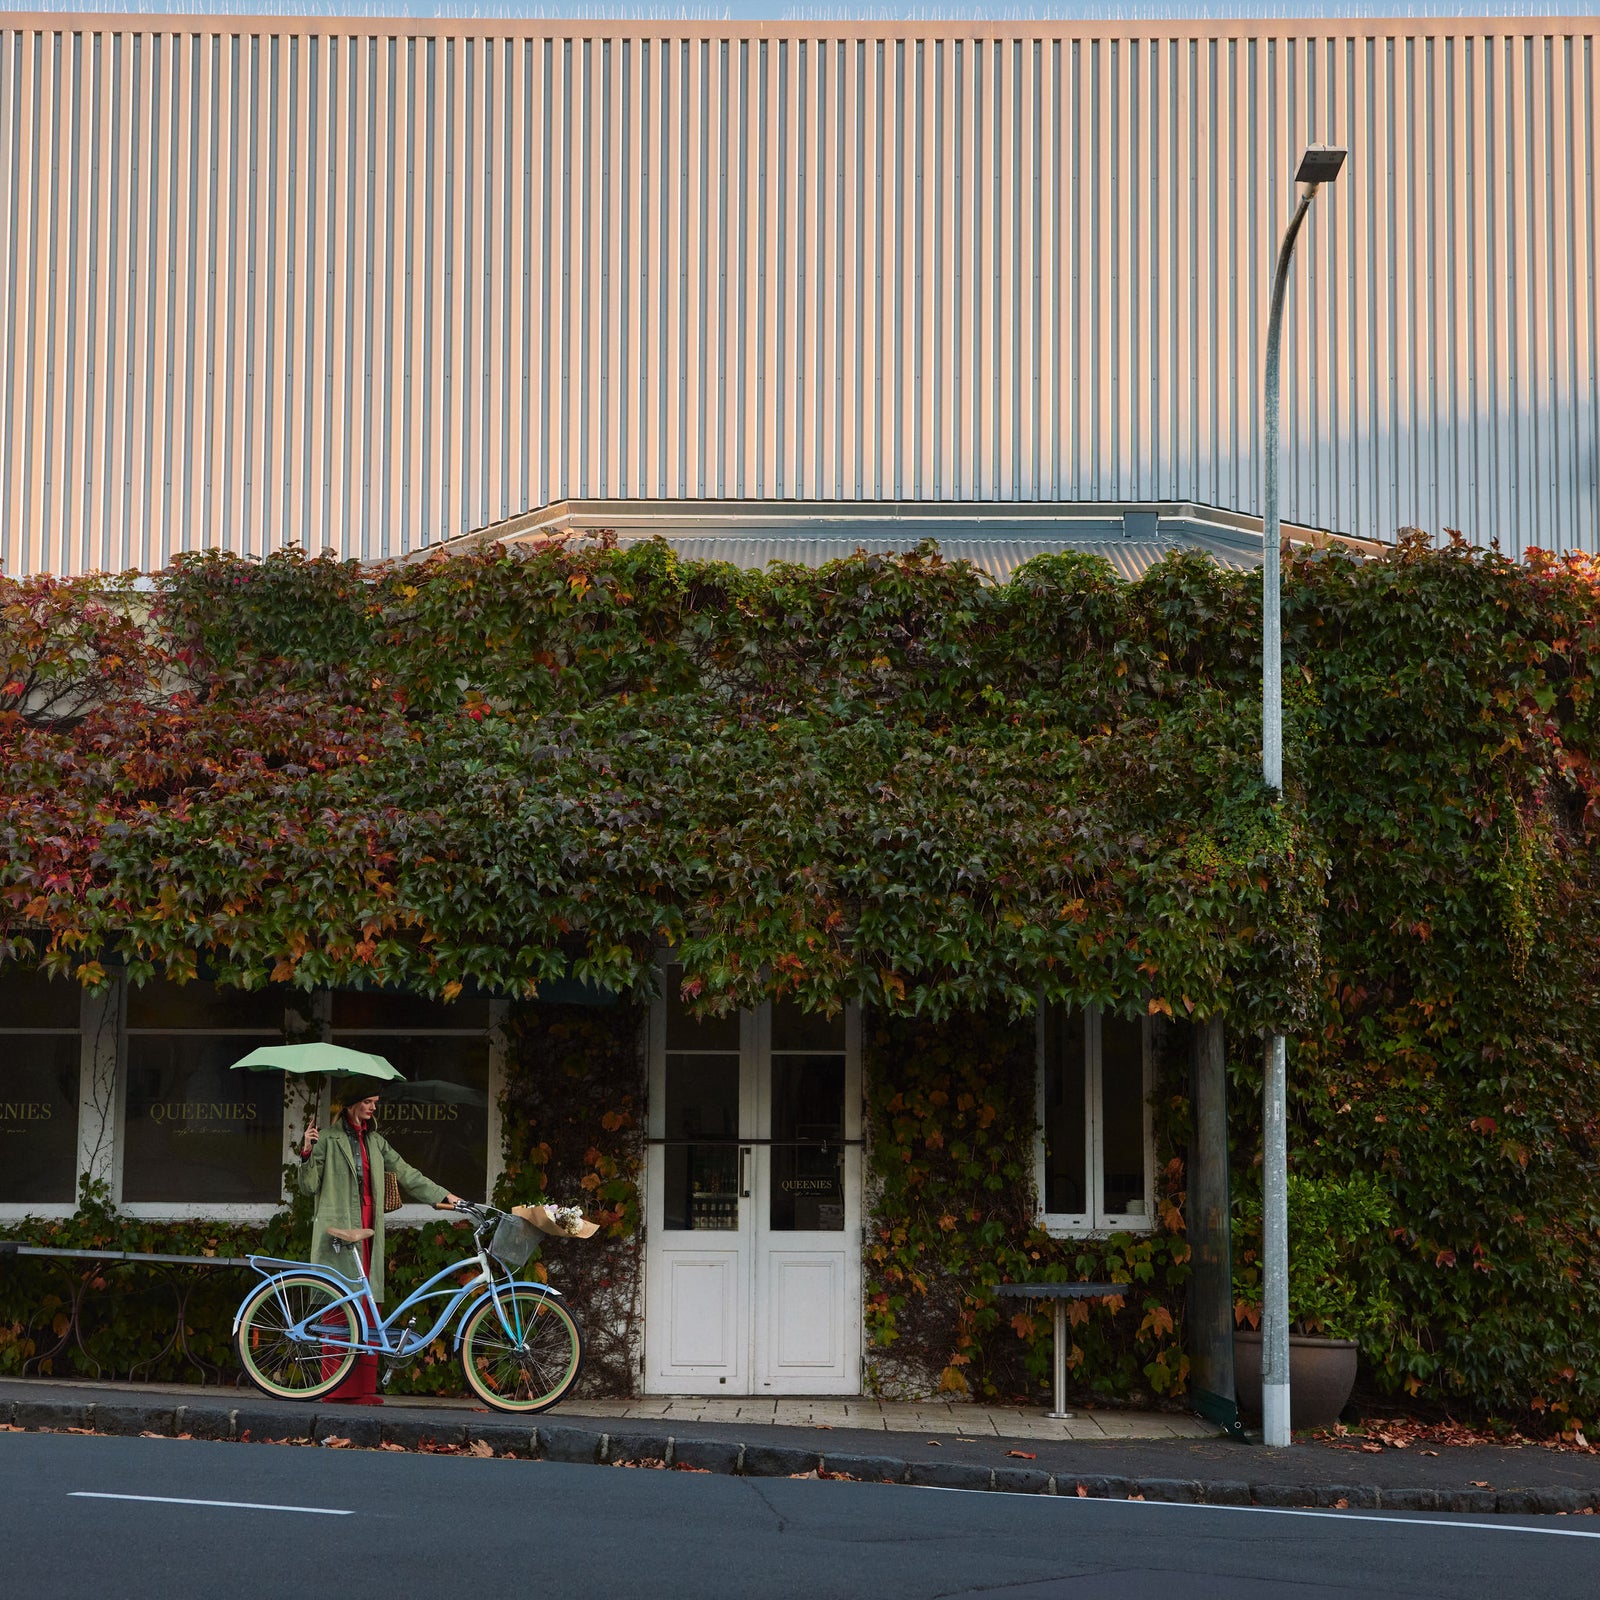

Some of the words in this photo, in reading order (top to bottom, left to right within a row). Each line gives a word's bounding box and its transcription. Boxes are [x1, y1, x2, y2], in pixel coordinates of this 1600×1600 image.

[0, 1103, 52, 1120] NIES
[149, 1103, 257, 1124] QUEENIES
[376, 1103, 458, 1121] EENIES
[781, 1180, 833, 1191] QUEENIES
